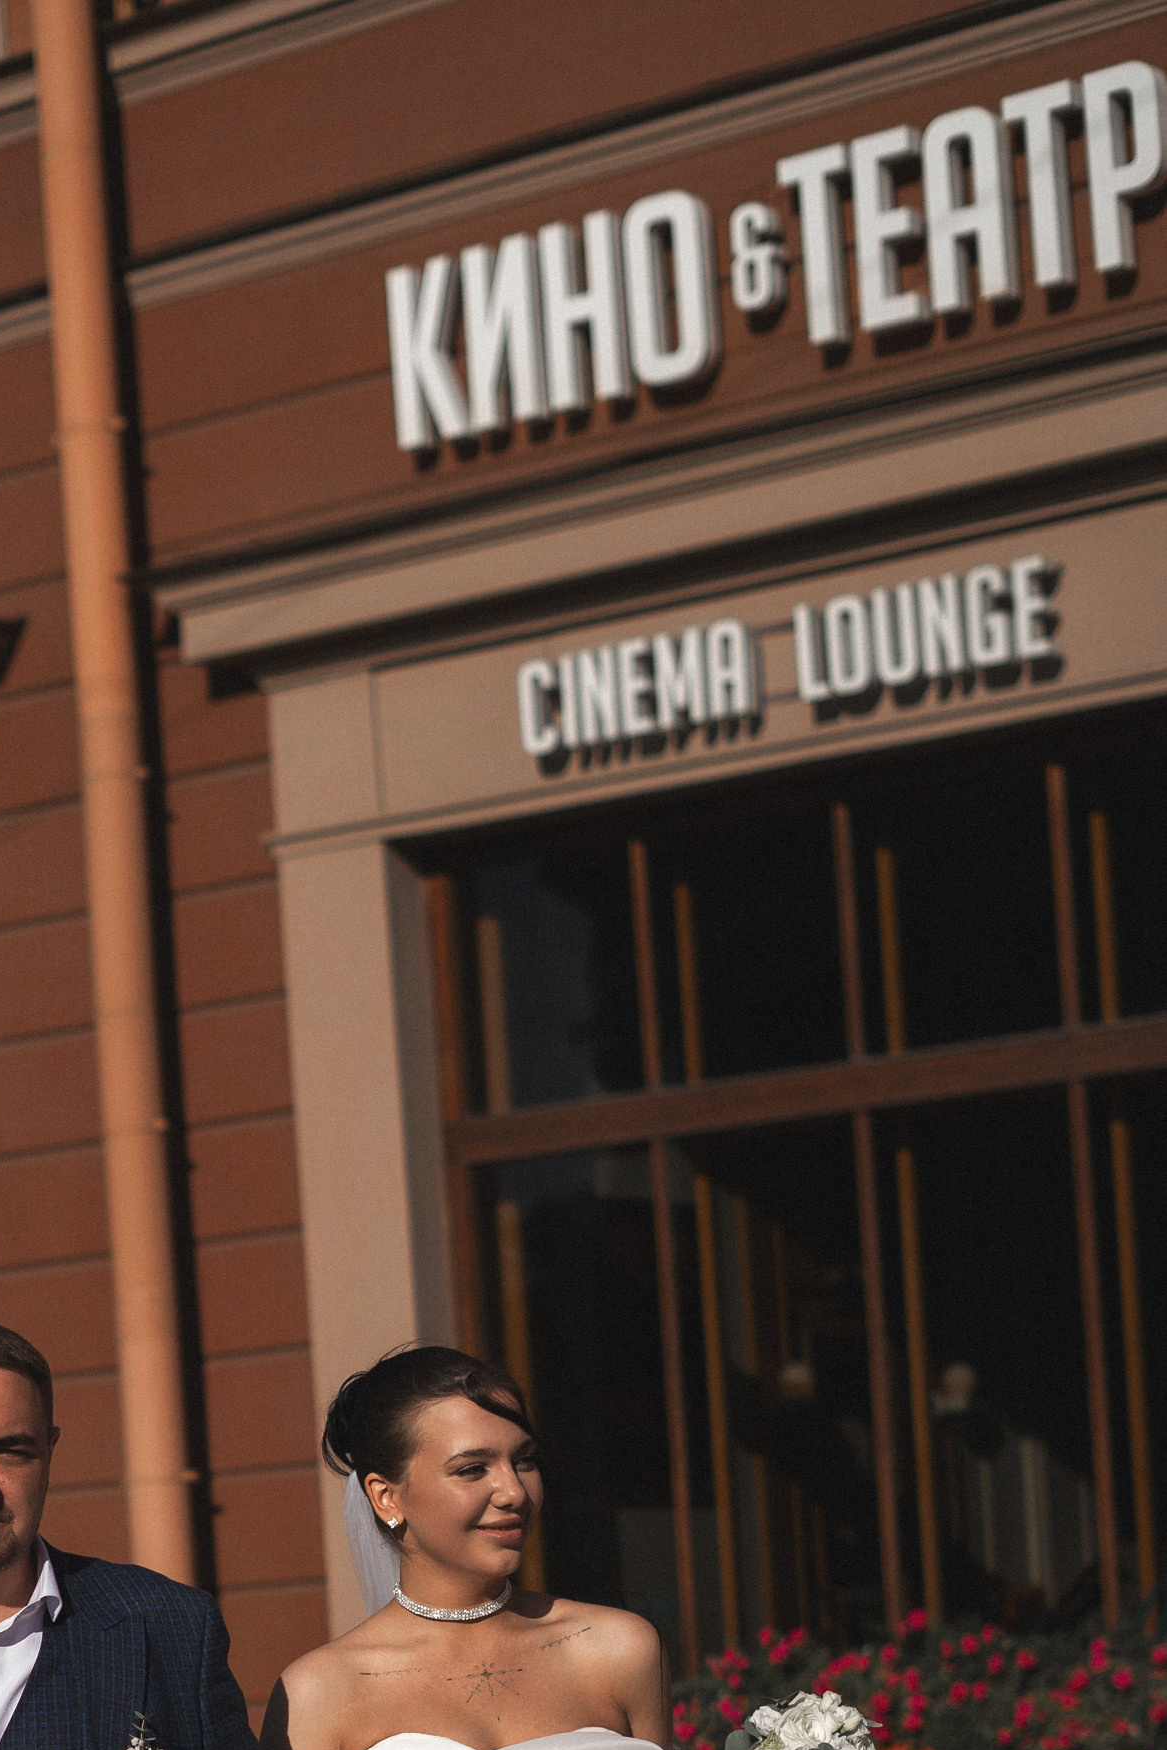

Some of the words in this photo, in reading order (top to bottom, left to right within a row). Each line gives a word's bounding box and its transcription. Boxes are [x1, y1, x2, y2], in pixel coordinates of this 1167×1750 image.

[385, 189, 716, 451] КИНО
[729, 201, 786, 312] &
[776, 60, 1167, 346] ТЕАТР
[516, 617, 760, 758] CINEMA
[793, 553, 1056, 703] LOUNGE
